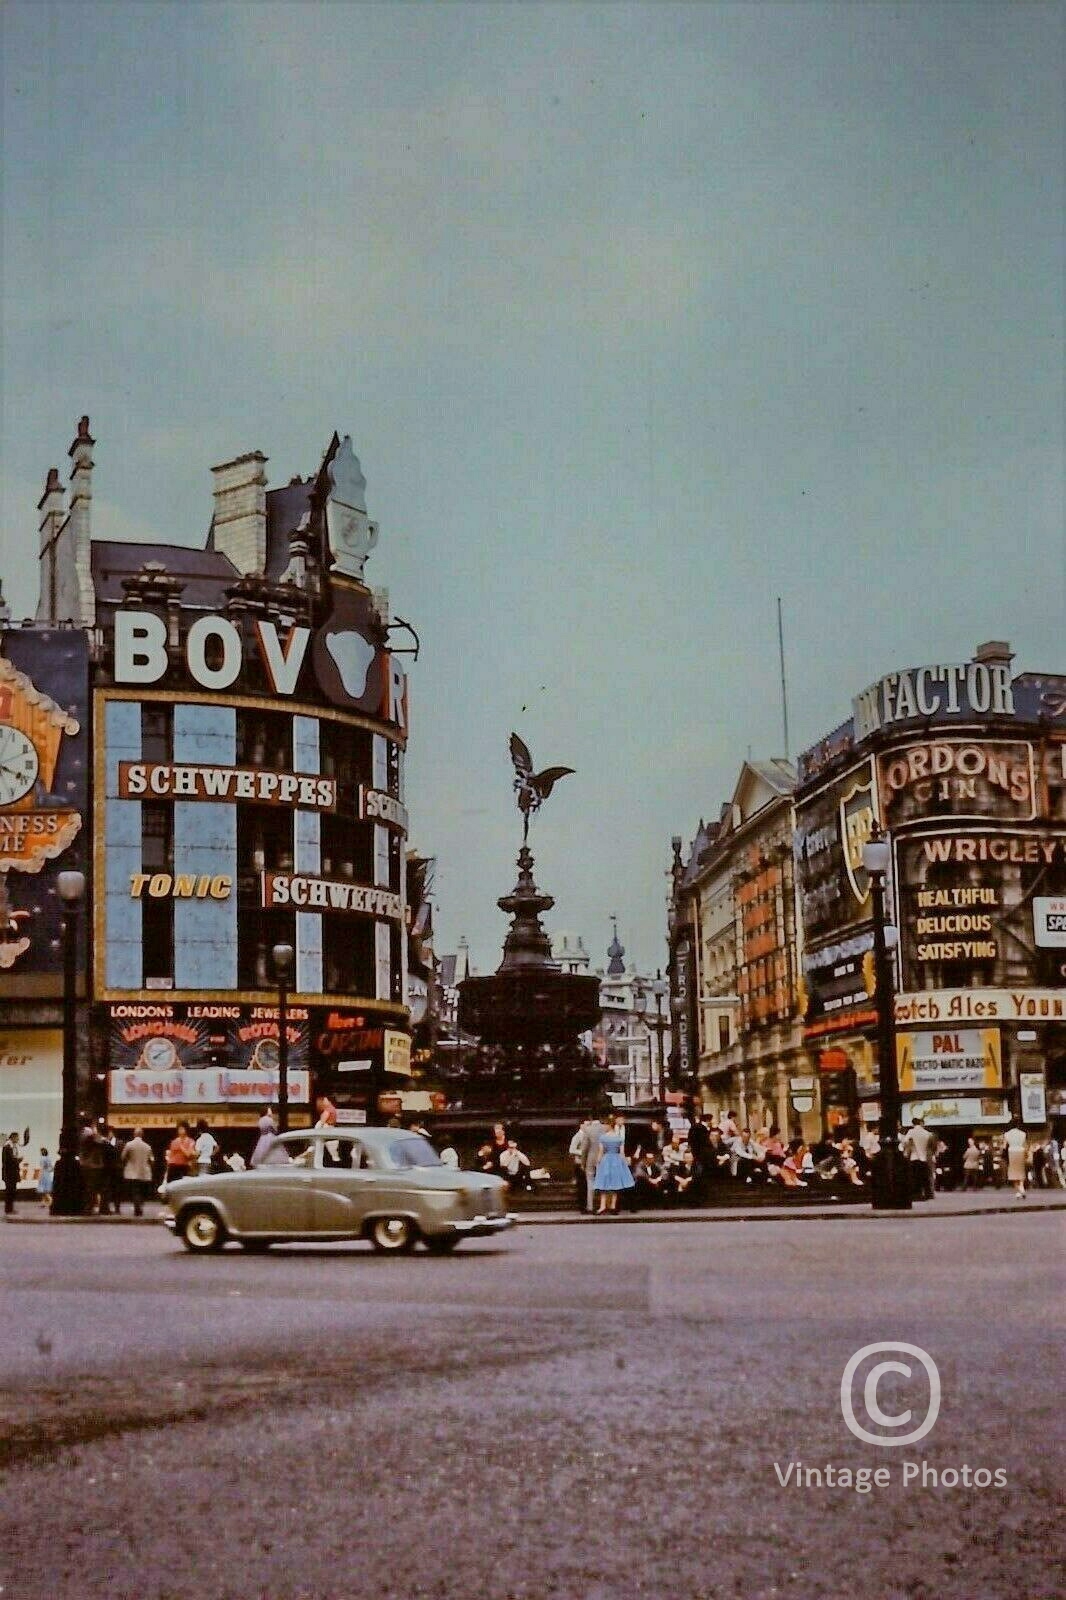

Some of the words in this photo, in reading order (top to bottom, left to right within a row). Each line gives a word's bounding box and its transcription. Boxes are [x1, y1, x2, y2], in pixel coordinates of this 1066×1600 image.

[883, 663, 1017, 725] FACTOR
[127, 764, 334, 808] SCHWEPPES
[130, 873, 232, 898] TONIC
[917, 888, 998, 907] HEALTHFUL
[917, 915, 991, 934] DELICIOUS
[917, 941, 996, 960] SATISFYING
[187, 1006, 241, 1019] LEADING
[250, 1006, 309, 1020] JEWELERS
[947, 995, 998, 1017] Ales
[932, 1034, 965, 1053] PAL
